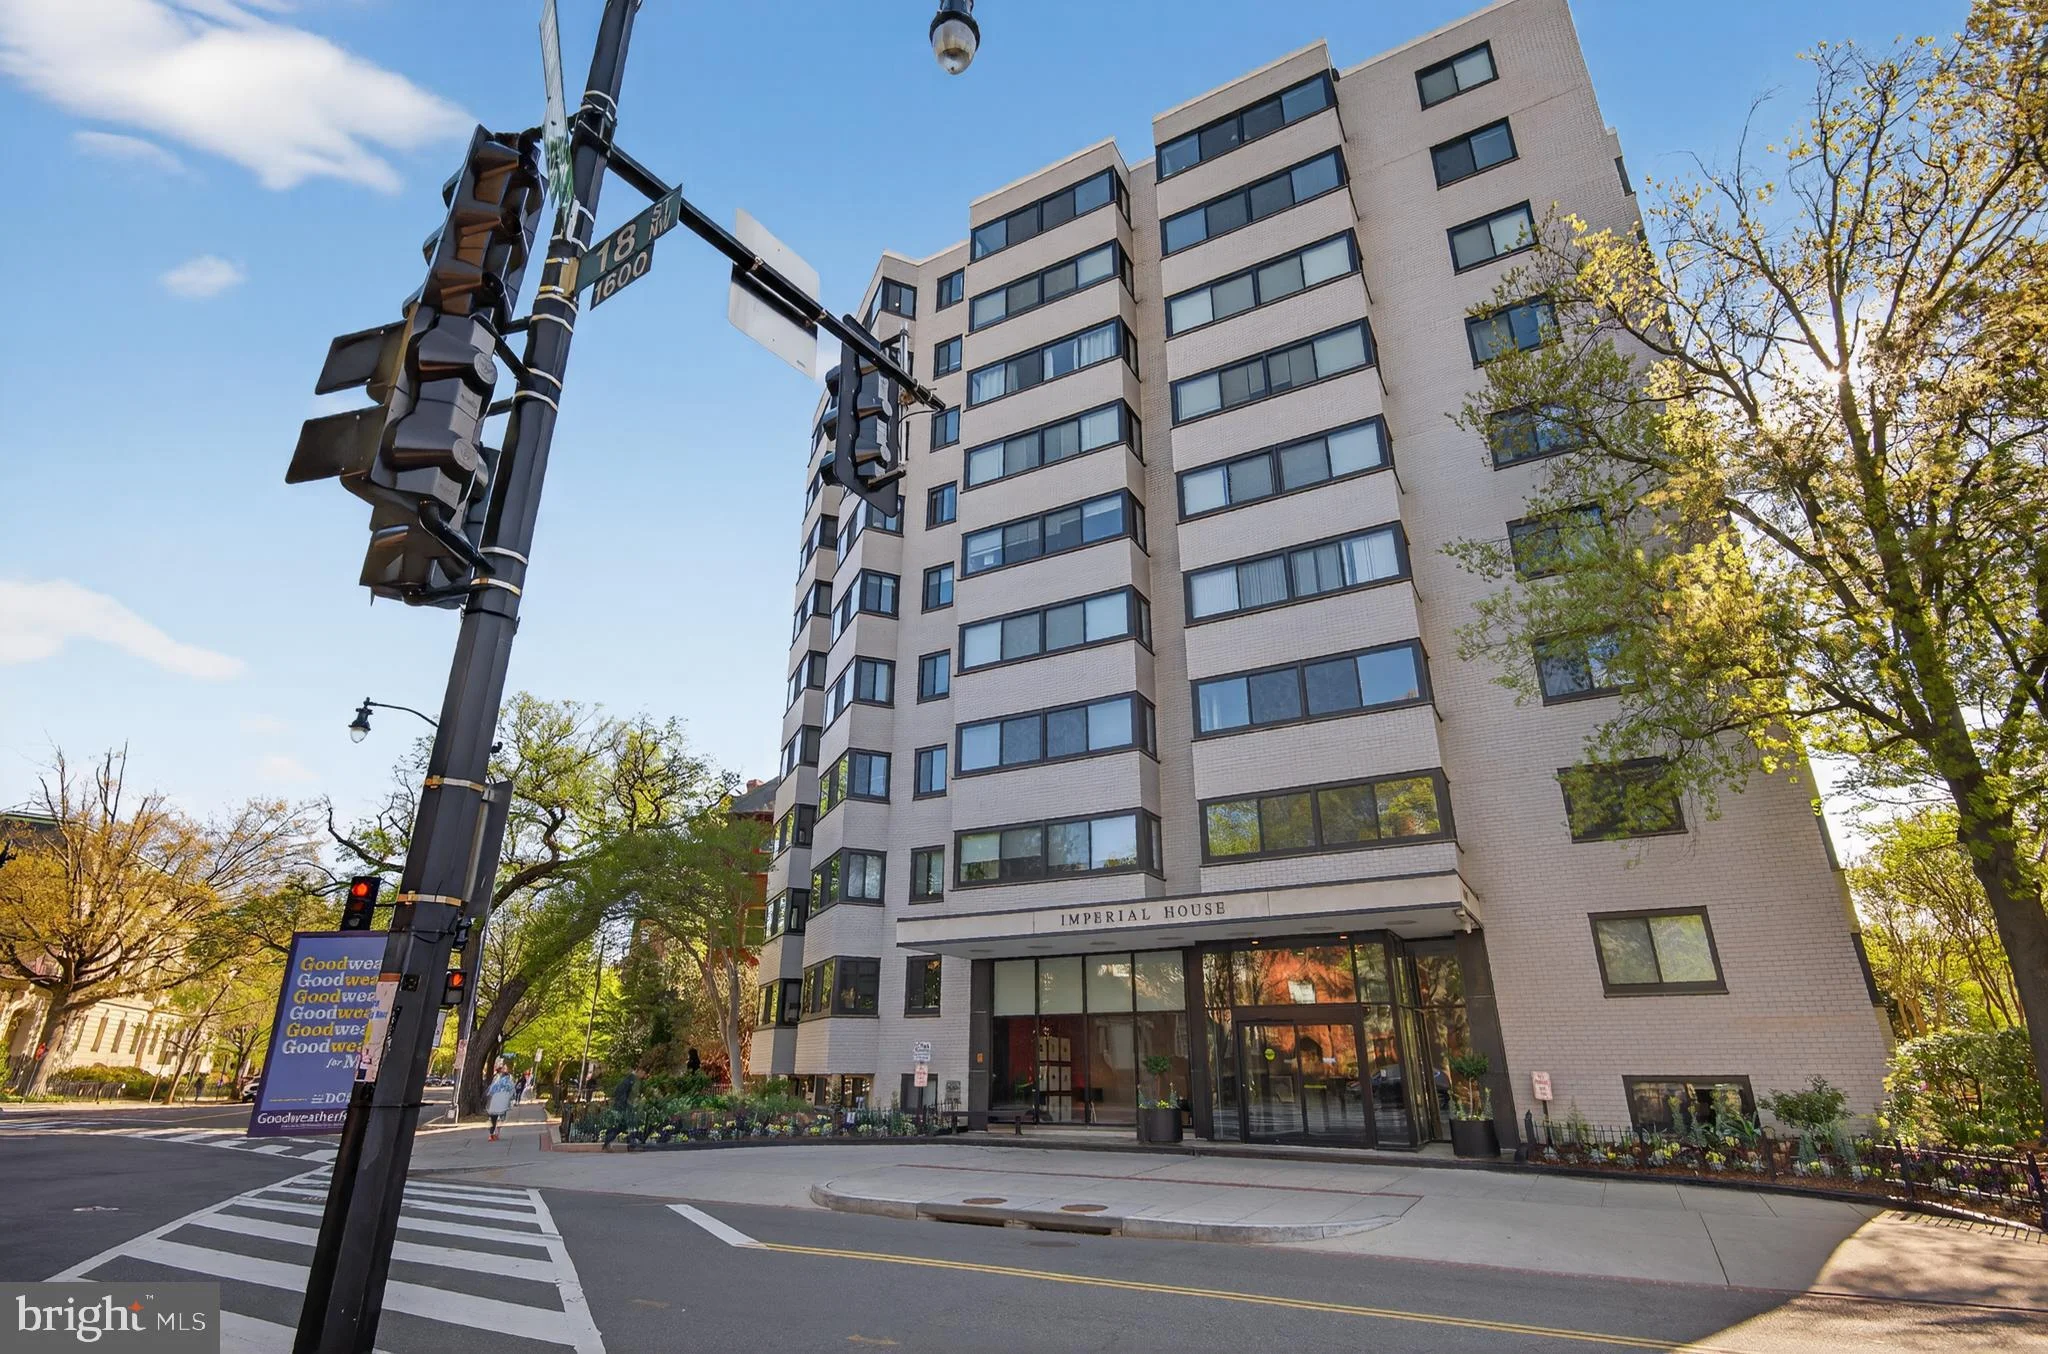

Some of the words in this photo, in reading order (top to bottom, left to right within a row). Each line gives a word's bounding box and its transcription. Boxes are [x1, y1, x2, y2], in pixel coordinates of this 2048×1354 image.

[652, 195, 674, 220] ST
[649, 213, 671, 240] NW
[596, 223, 637, 273] 18
[595, 252, 648, 304] 1600
[1061, 908, 1151, 926] IMPERIAL
[1164, 902, 1226, 919] HOUSE
[326, 1057, 343, 1069] for
